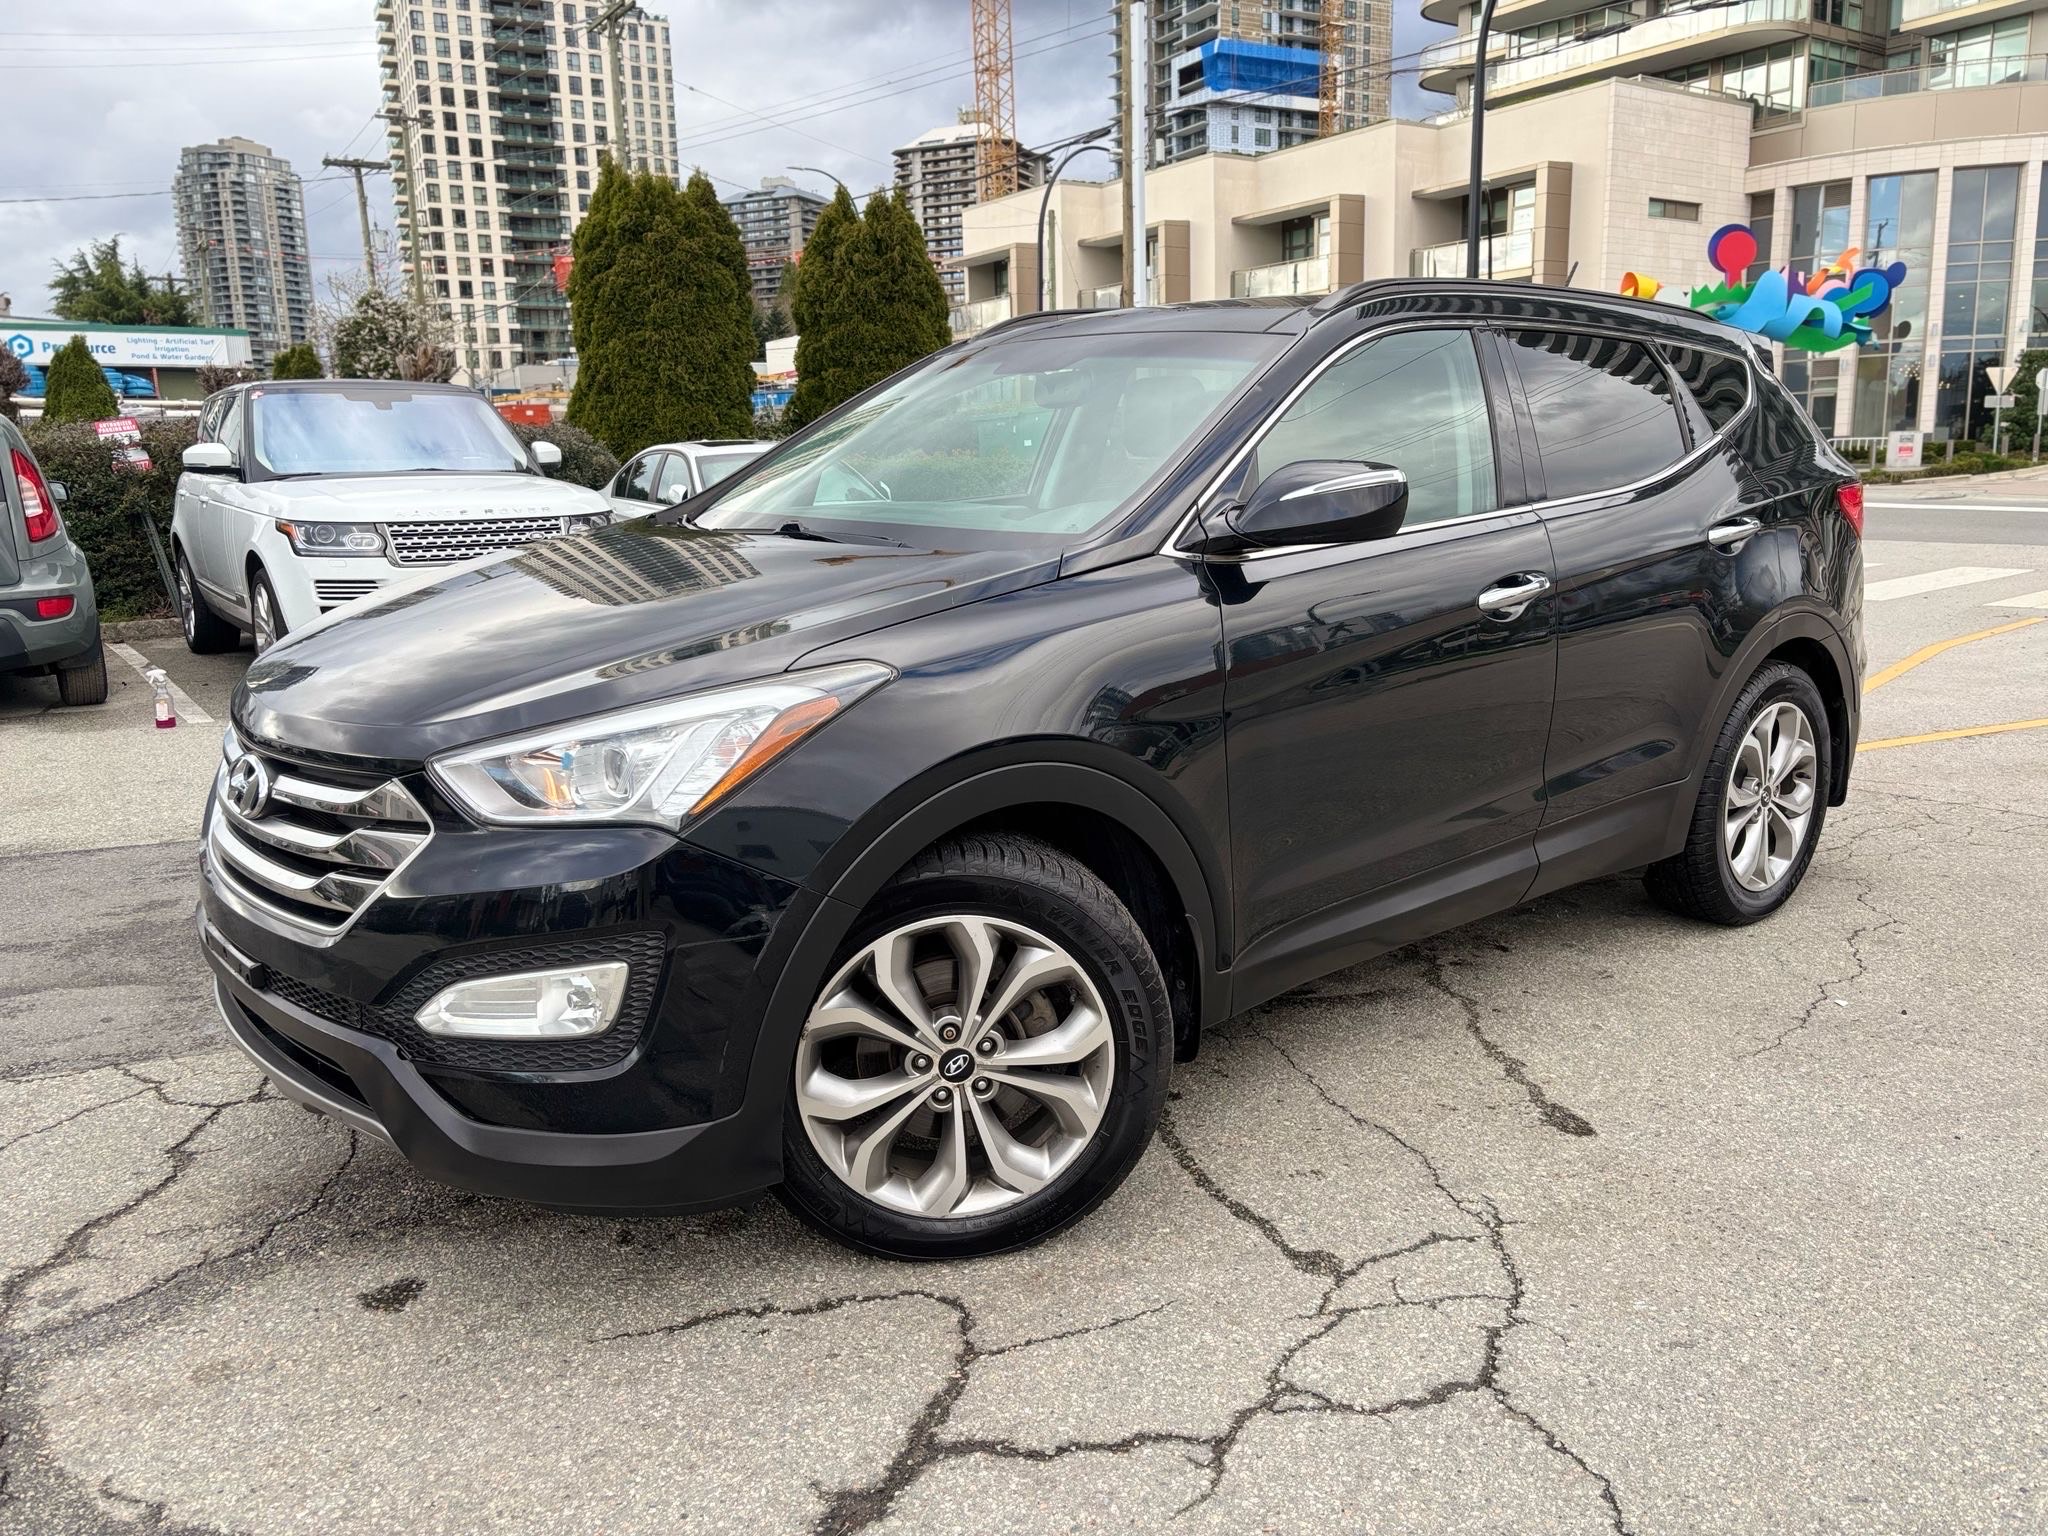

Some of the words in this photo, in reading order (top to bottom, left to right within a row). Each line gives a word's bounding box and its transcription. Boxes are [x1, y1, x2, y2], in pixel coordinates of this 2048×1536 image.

[42, 341, 116, 354] Prource
[126, 337, 158, 345] Lighting
[1120, 989, 1148, 1051] EDGE
